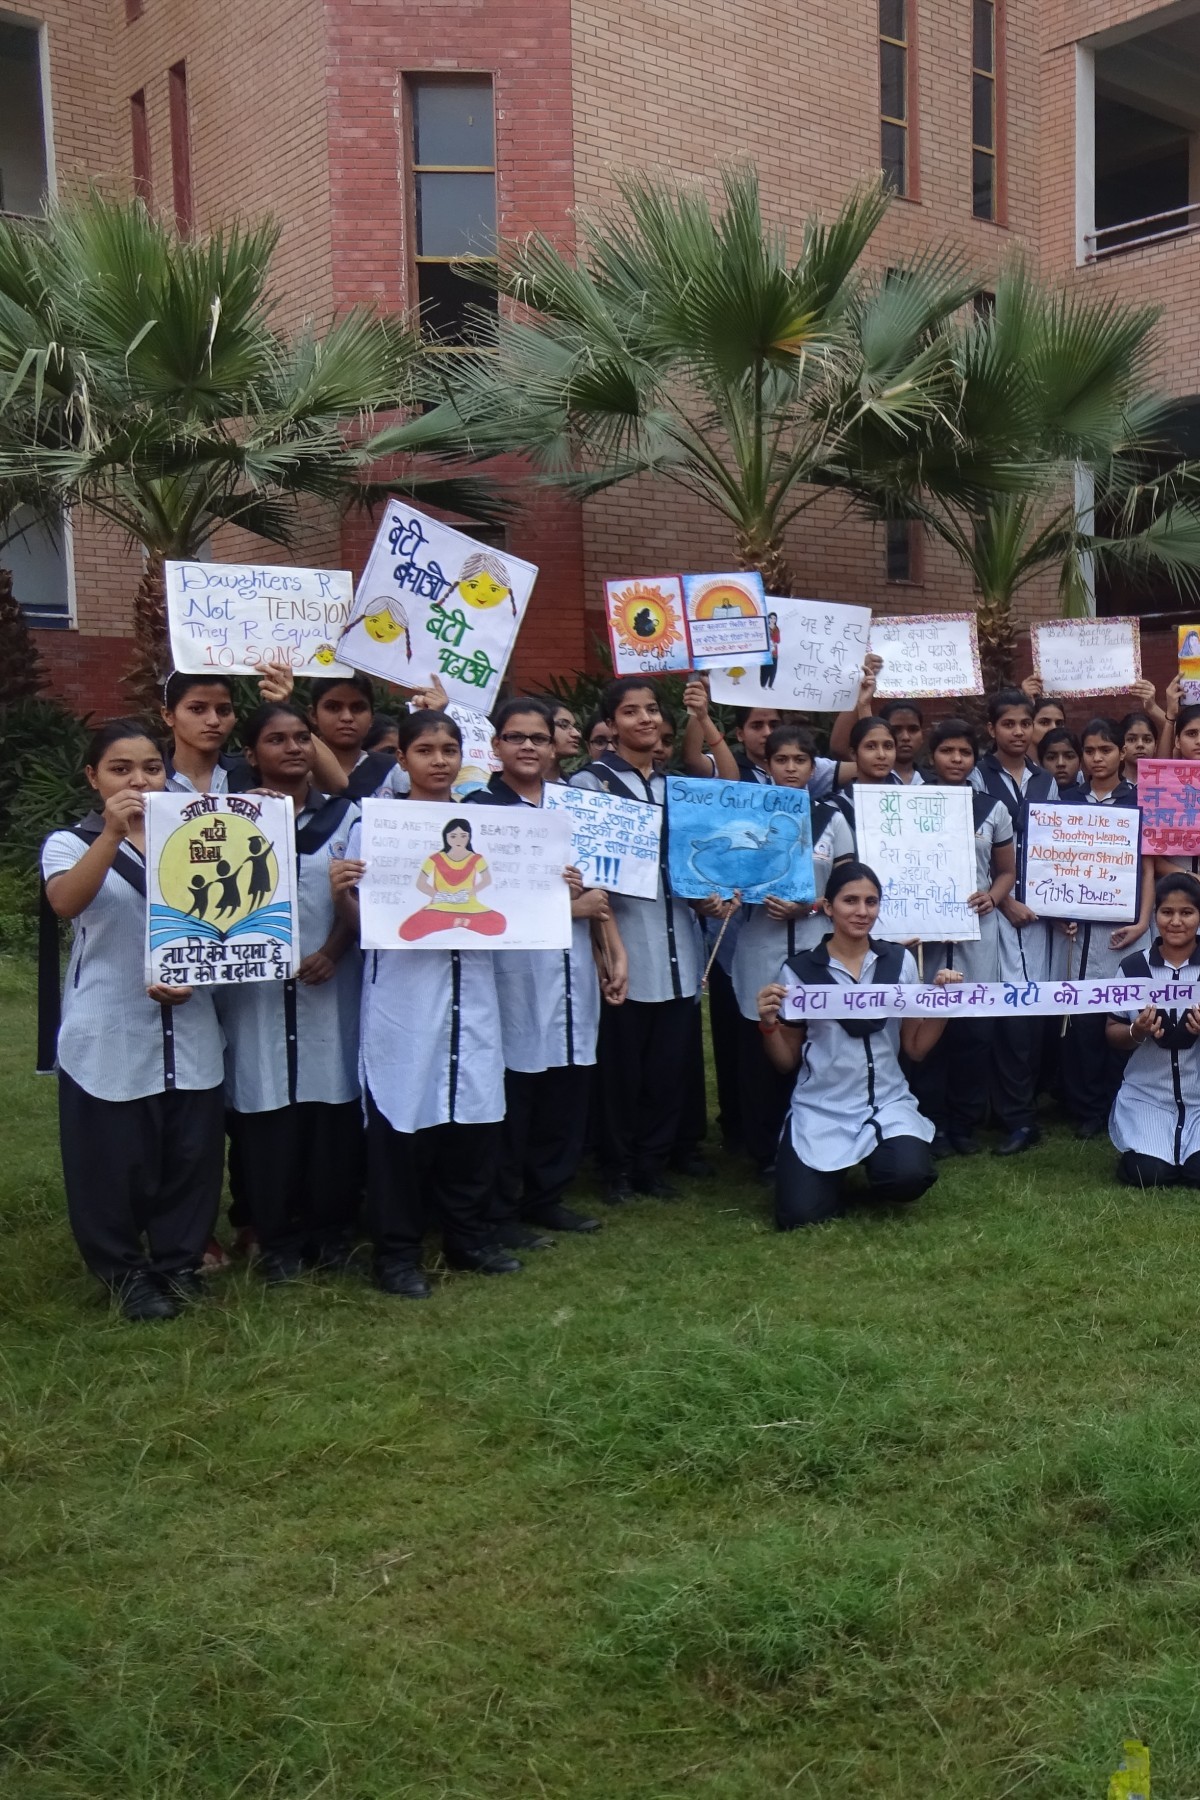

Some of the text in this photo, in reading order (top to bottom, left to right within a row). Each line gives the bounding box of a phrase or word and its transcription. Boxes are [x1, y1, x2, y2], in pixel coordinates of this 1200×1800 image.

[388, 515, 430, 562] बेटी
[174, 565, 341, 600] Daughters R
[393, 560, 452, 601] बचाओ
[182, 595, 352, 624] Not TENSION
[181, 621, 333, 648] They R Equal
[426, 602, 474, 647] बेटी
[203, 645, 305, 668] 10 SONS
[618, 642, 648, 657] Save
[672, 780, 804, 814] Save Girl Child
[1067, 814, 1083, 826] are
[1116, 818, 1130, 828] as
[1052, 829, 1094, 846] Shooting
[1029, 845, 1077, 867] Nobody
[1078, 852, 1095, 861] can
[1083, 865, 1094, 878] of
[162, 937, 207, 964] नारी
[206, 941, 228, 961] को
[159, 963, 190, 985] देश
[194, 960, 217, 982] को
[792, 986, 831, 1013] बेटा
[893, 986, 906, 1012] है
[916, 984, 964, 1009] कॉलेज
[1003, 981, 1042, 1007] बेटी
[1053, 982, 1083, 1006] को
[1088, 984, 1146, 1006] अक्षर
[1149, 984, 1197, 1004] ज्ञान
